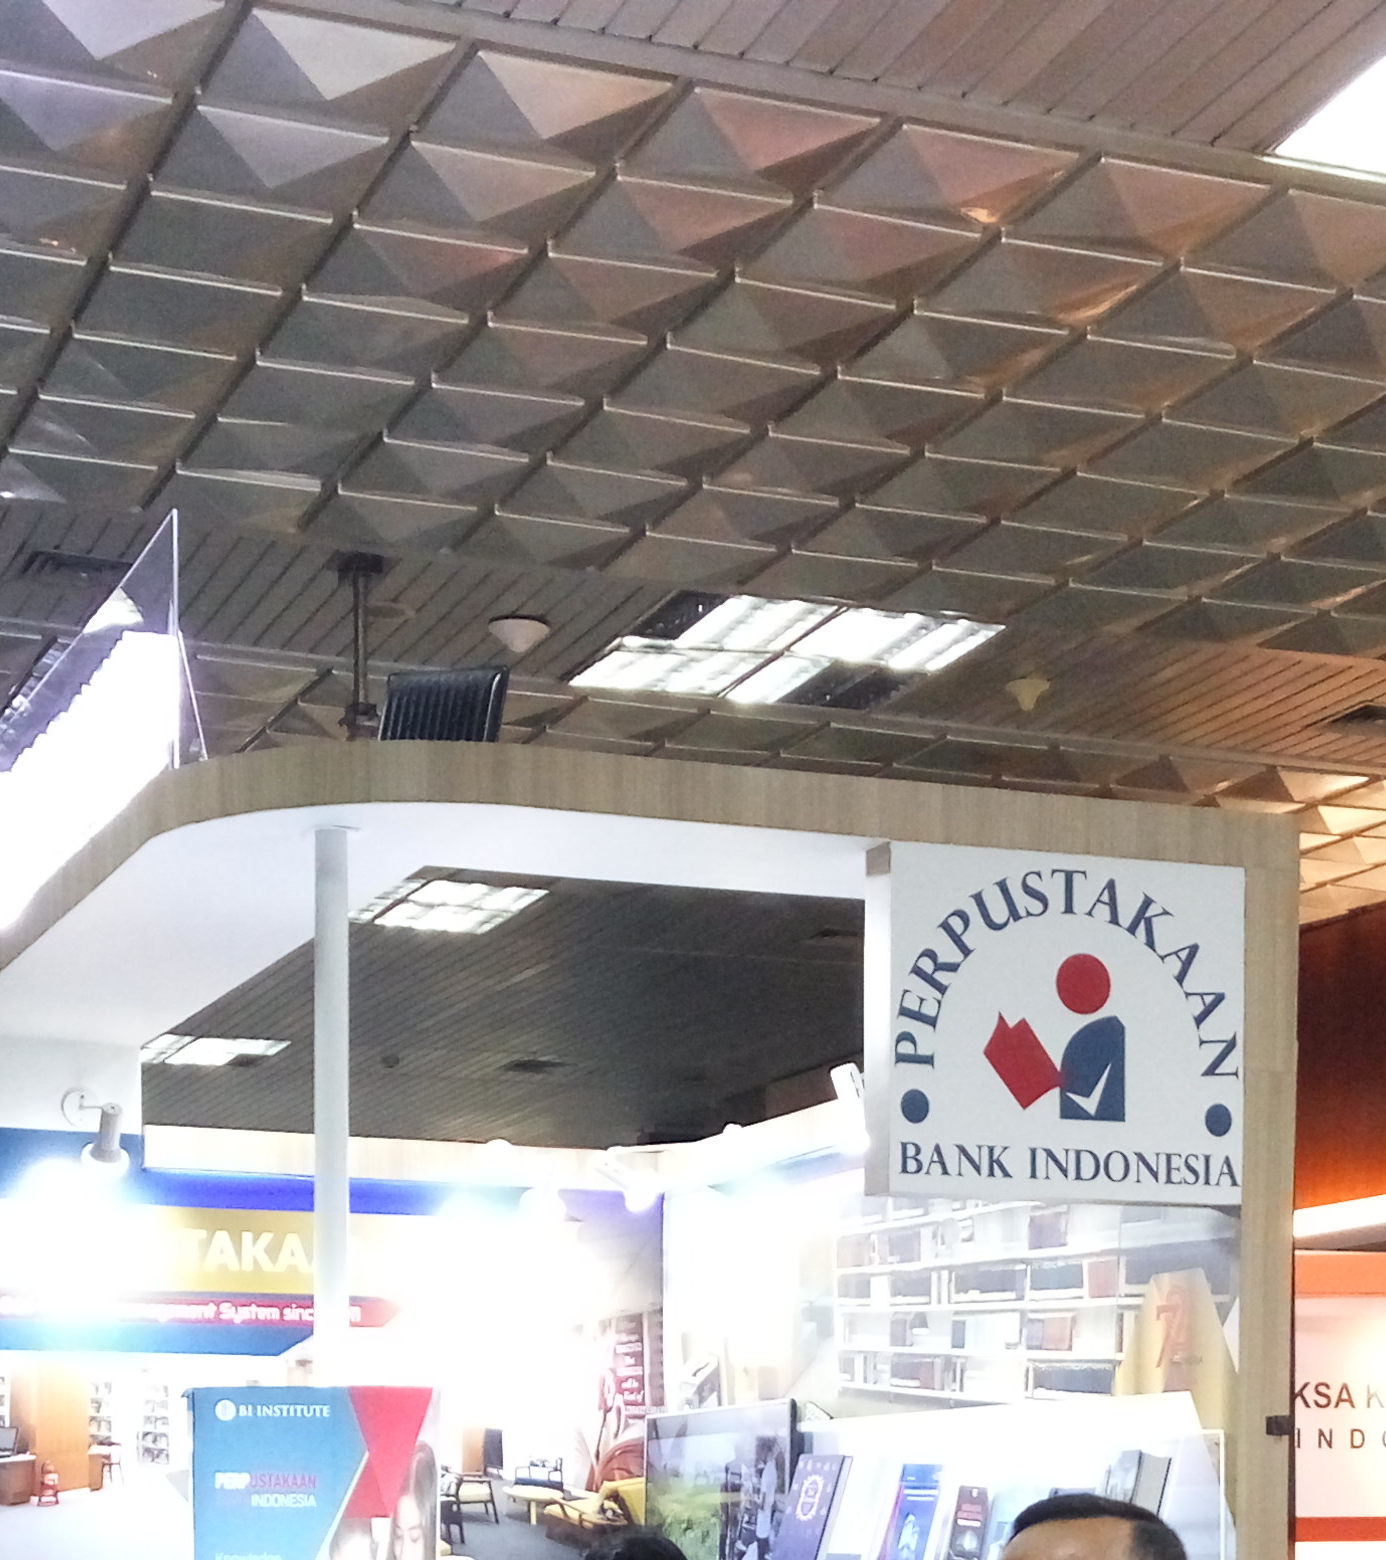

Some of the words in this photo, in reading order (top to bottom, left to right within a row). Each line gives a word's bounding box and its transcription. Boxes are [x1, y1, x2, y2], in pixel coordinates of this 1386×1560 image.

[894, 868, 1240, 1080] PERPUSTAKAAN
[899, 1141, 1013, 1180] BANK
[1028, 1146, 1241, 1187] INDONESIA
[220, 1302, 280, 1324] System
[283, 1303, 315, 1322] sinc
[238, 1405, 253, 1417] BI
[257, 1405, 331, 1418] INSTITUTE
[215, 1472, 317, 1490] PERPUSTAKAAN
[251, 1493, 317, 1508] INDONESIA
